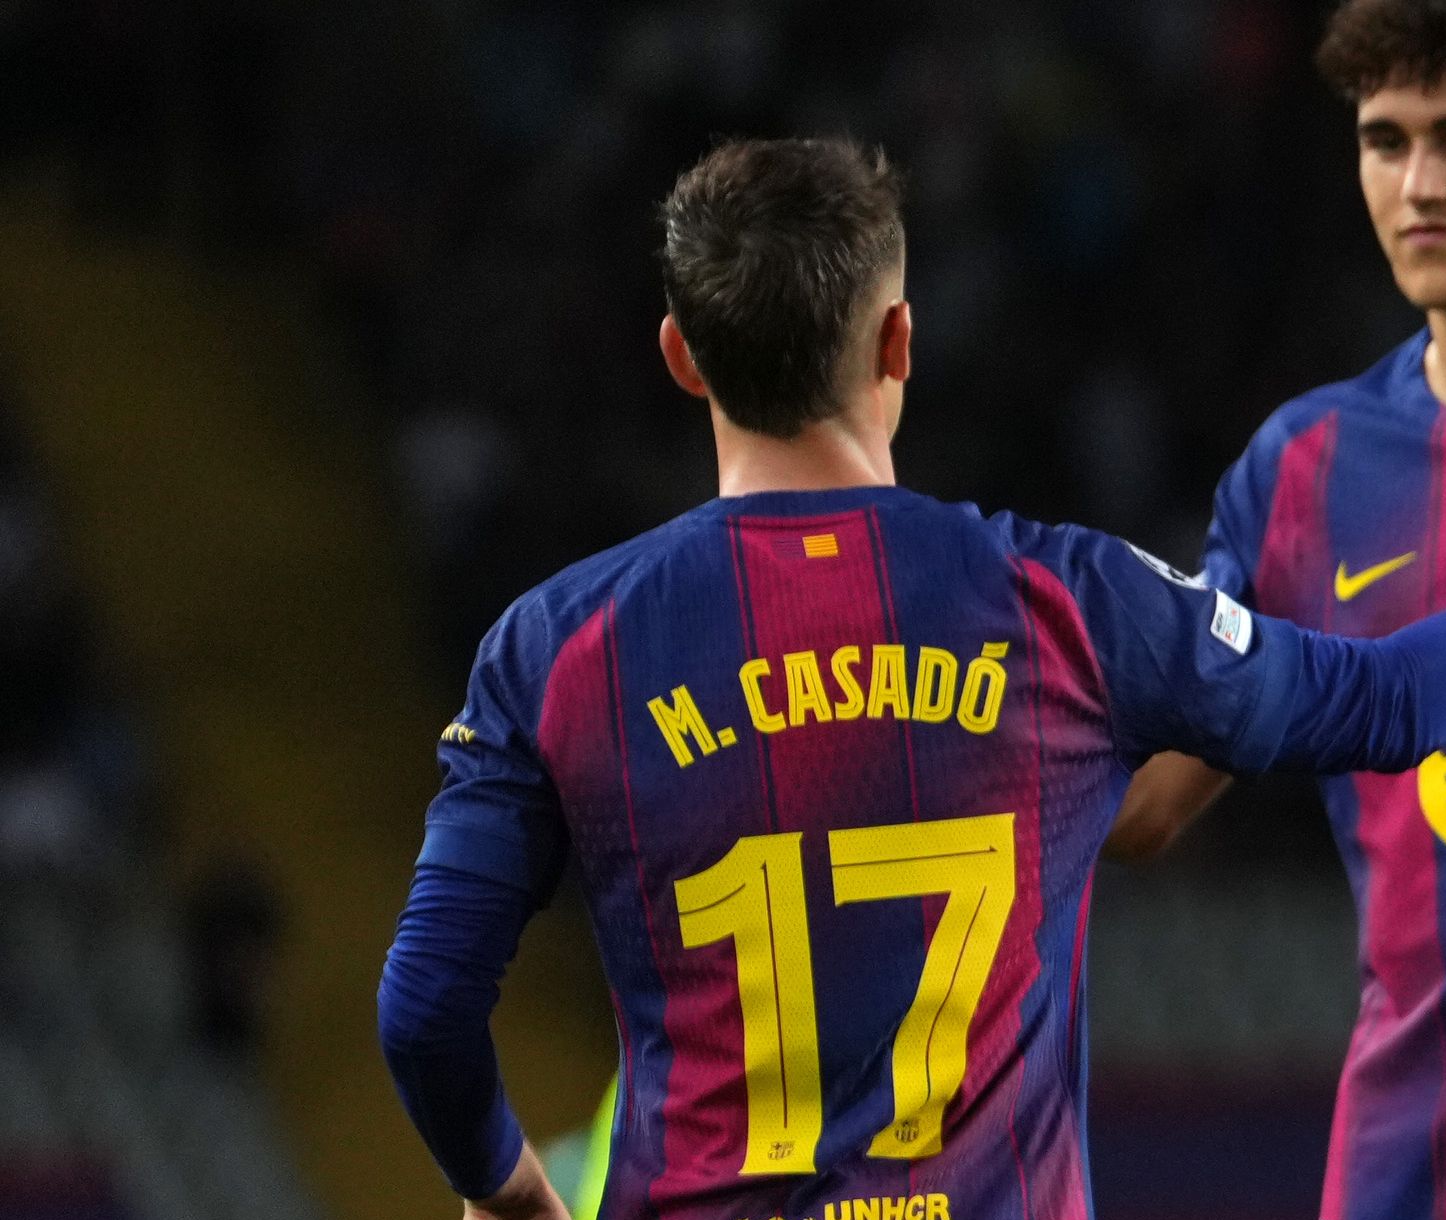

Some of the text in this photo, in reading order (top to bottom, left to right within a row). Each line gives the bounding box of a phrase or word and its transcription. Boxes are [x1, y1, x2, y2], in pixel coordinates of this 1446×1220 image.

[648, 642, 1010, 768] M. CASADÓ
[674, 812, 1017, 1175] 17
